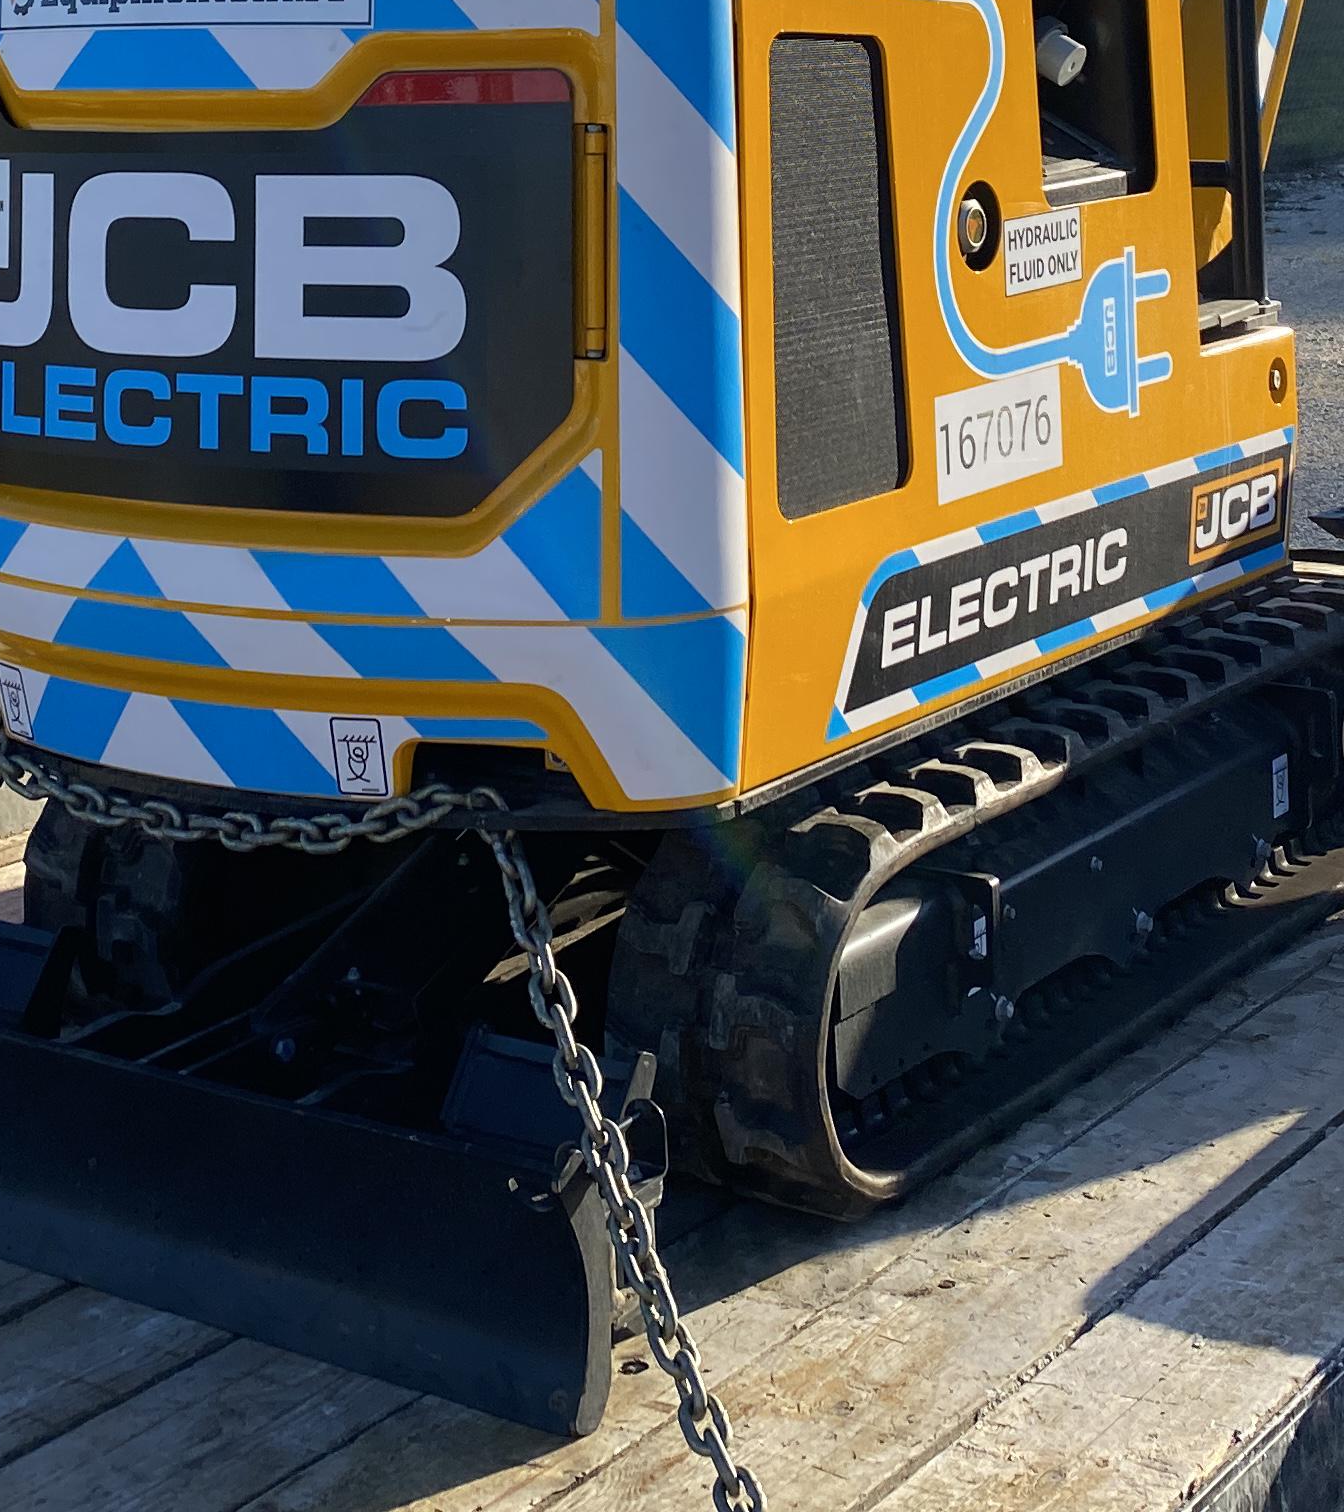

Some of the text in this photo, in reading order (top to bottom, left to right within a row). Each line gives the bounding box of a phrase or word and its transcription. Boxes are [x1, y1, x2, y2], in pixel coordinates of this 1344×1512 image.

[1008, 217, 1078, 252] HYDRAULIC
[1009, 249, 1078, 285] FLUID ONLY
[1103, 296, 1117, 377] JCB
[939, 394, 1052, 476] 167076
[1196, 473, 1276, 549] JCB
[881, 527, 1128, 669] ELECTRIC
